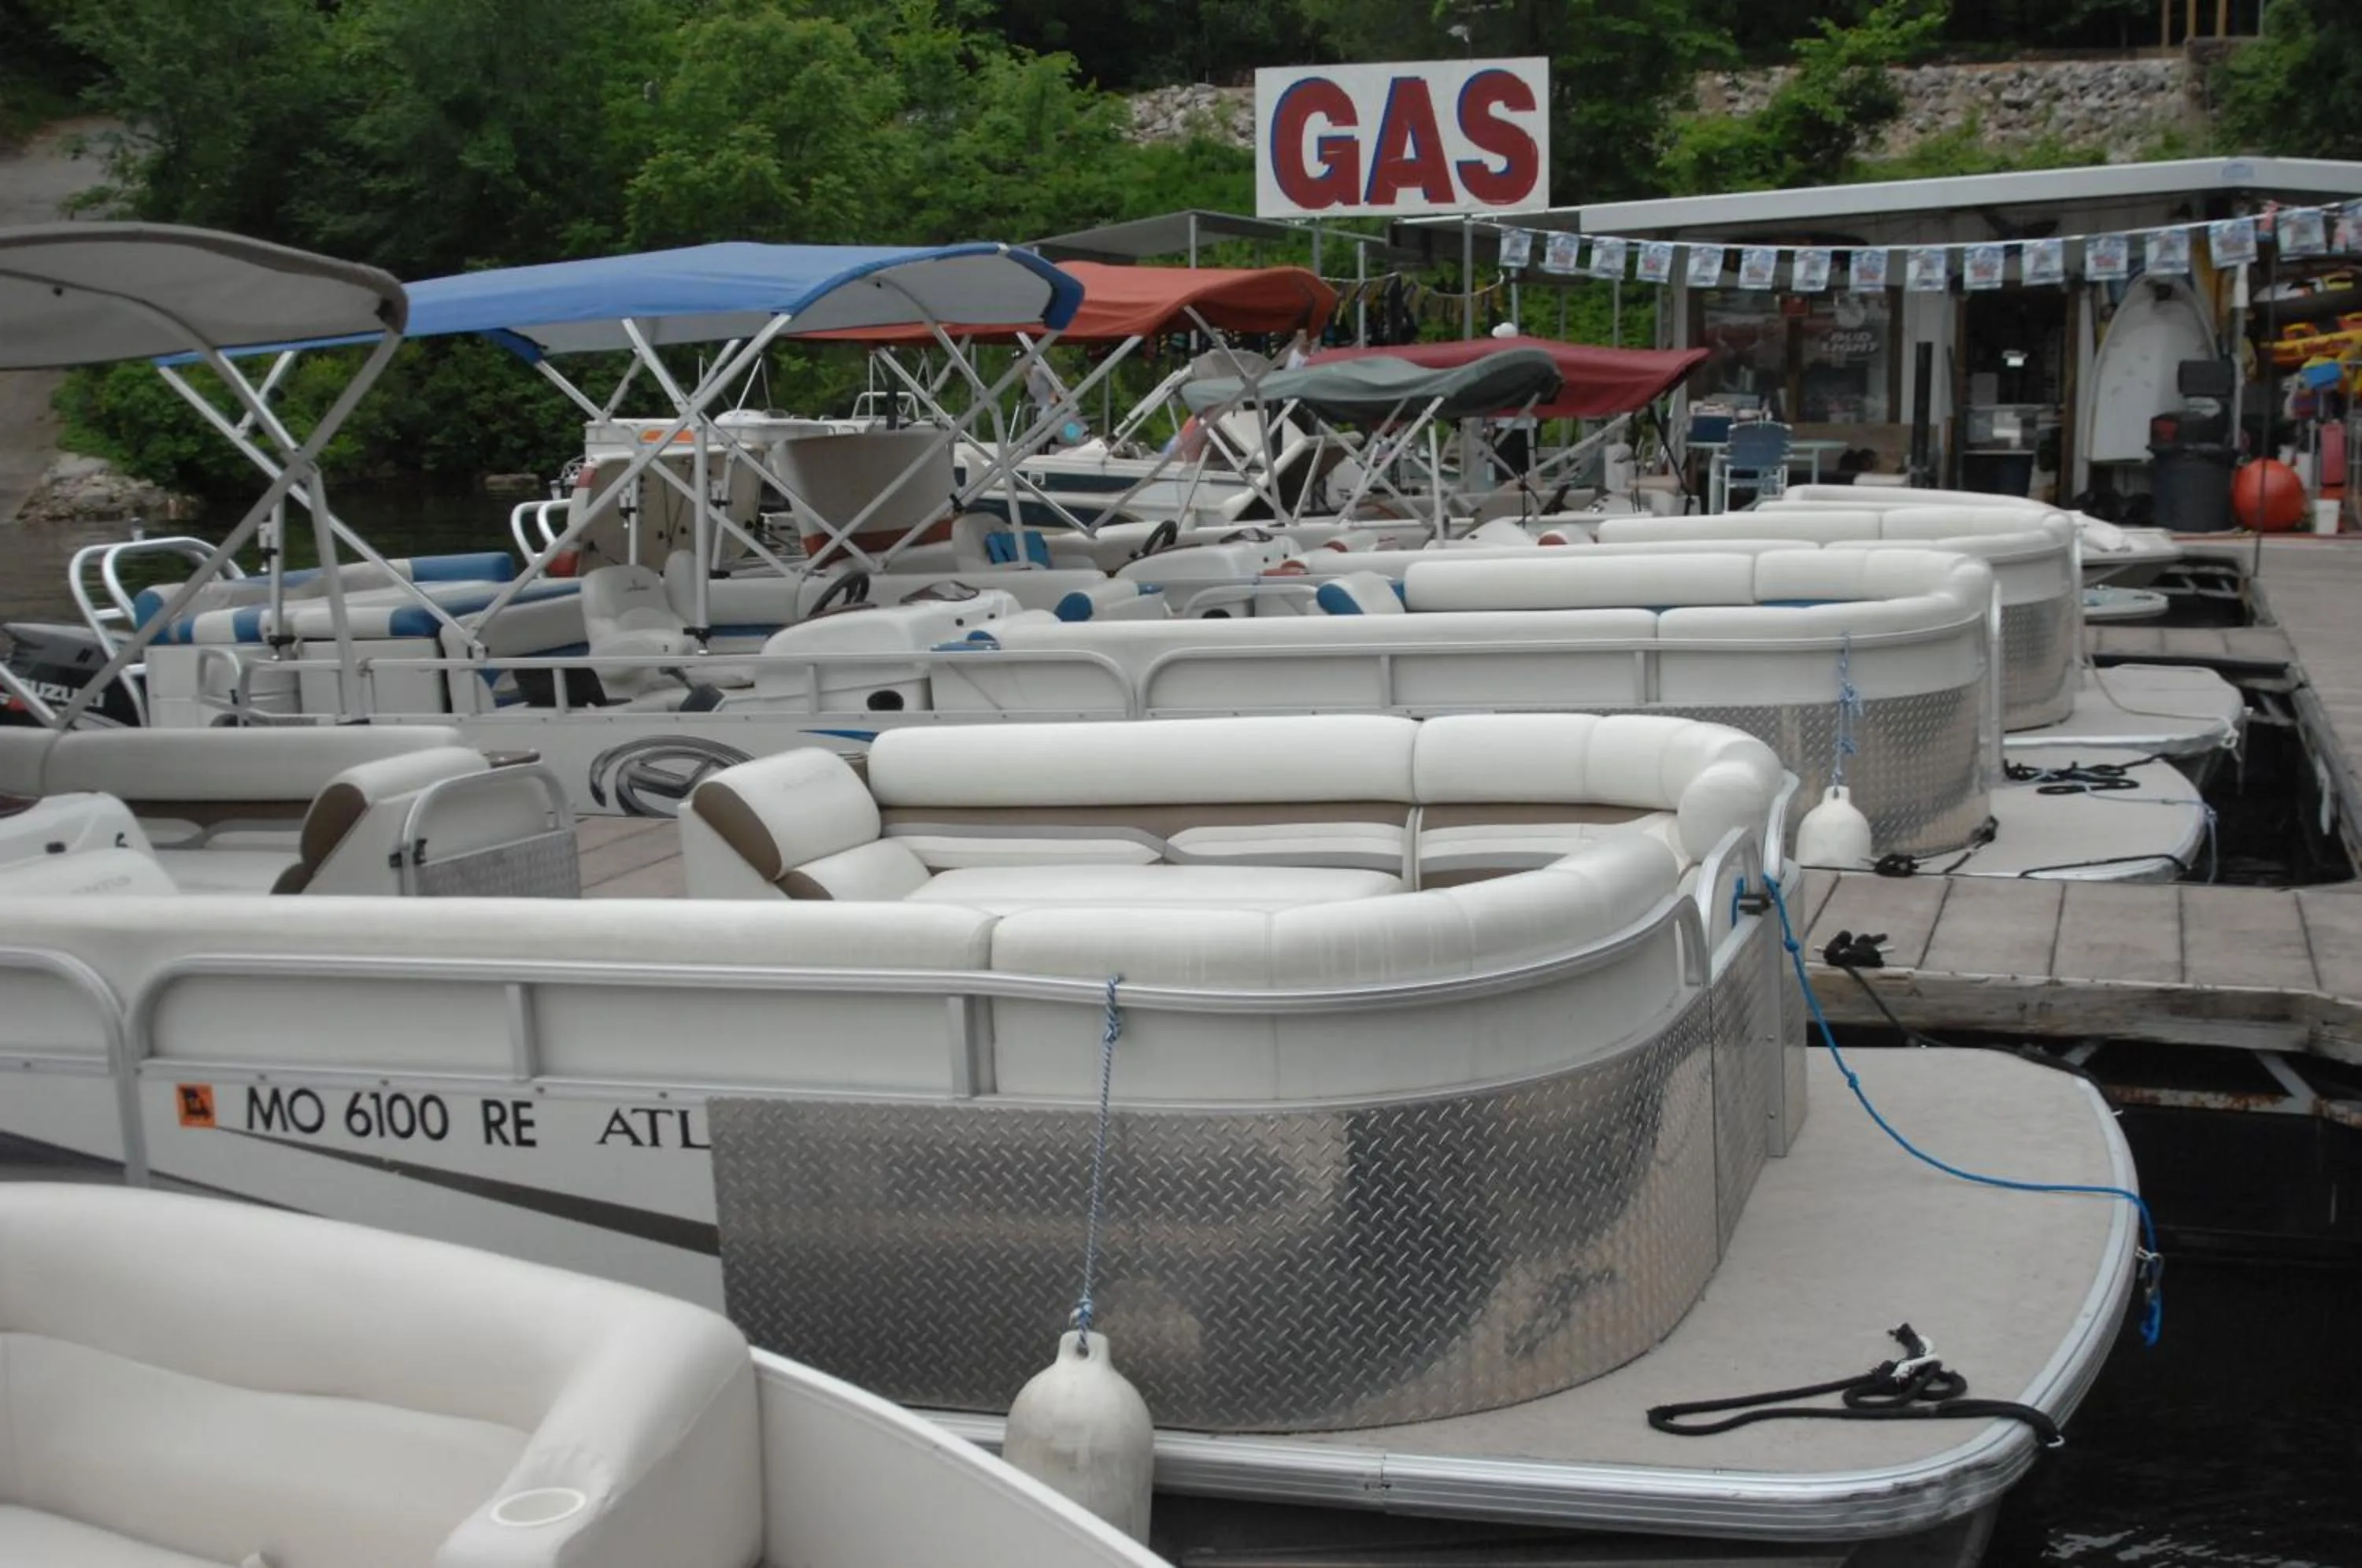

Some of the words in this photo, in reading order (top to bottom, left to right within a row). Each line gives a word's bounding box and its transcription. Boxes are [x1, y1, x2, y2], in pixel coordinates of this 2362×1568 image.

[1270, 68, 1538, 210] GAS
[246, 1086, 325, 1134] MO
[344, 1092, 450, 1141] 6100
[481, 1099, 537, 1147] RE
[595, 1108, 712, 1149] ATL
